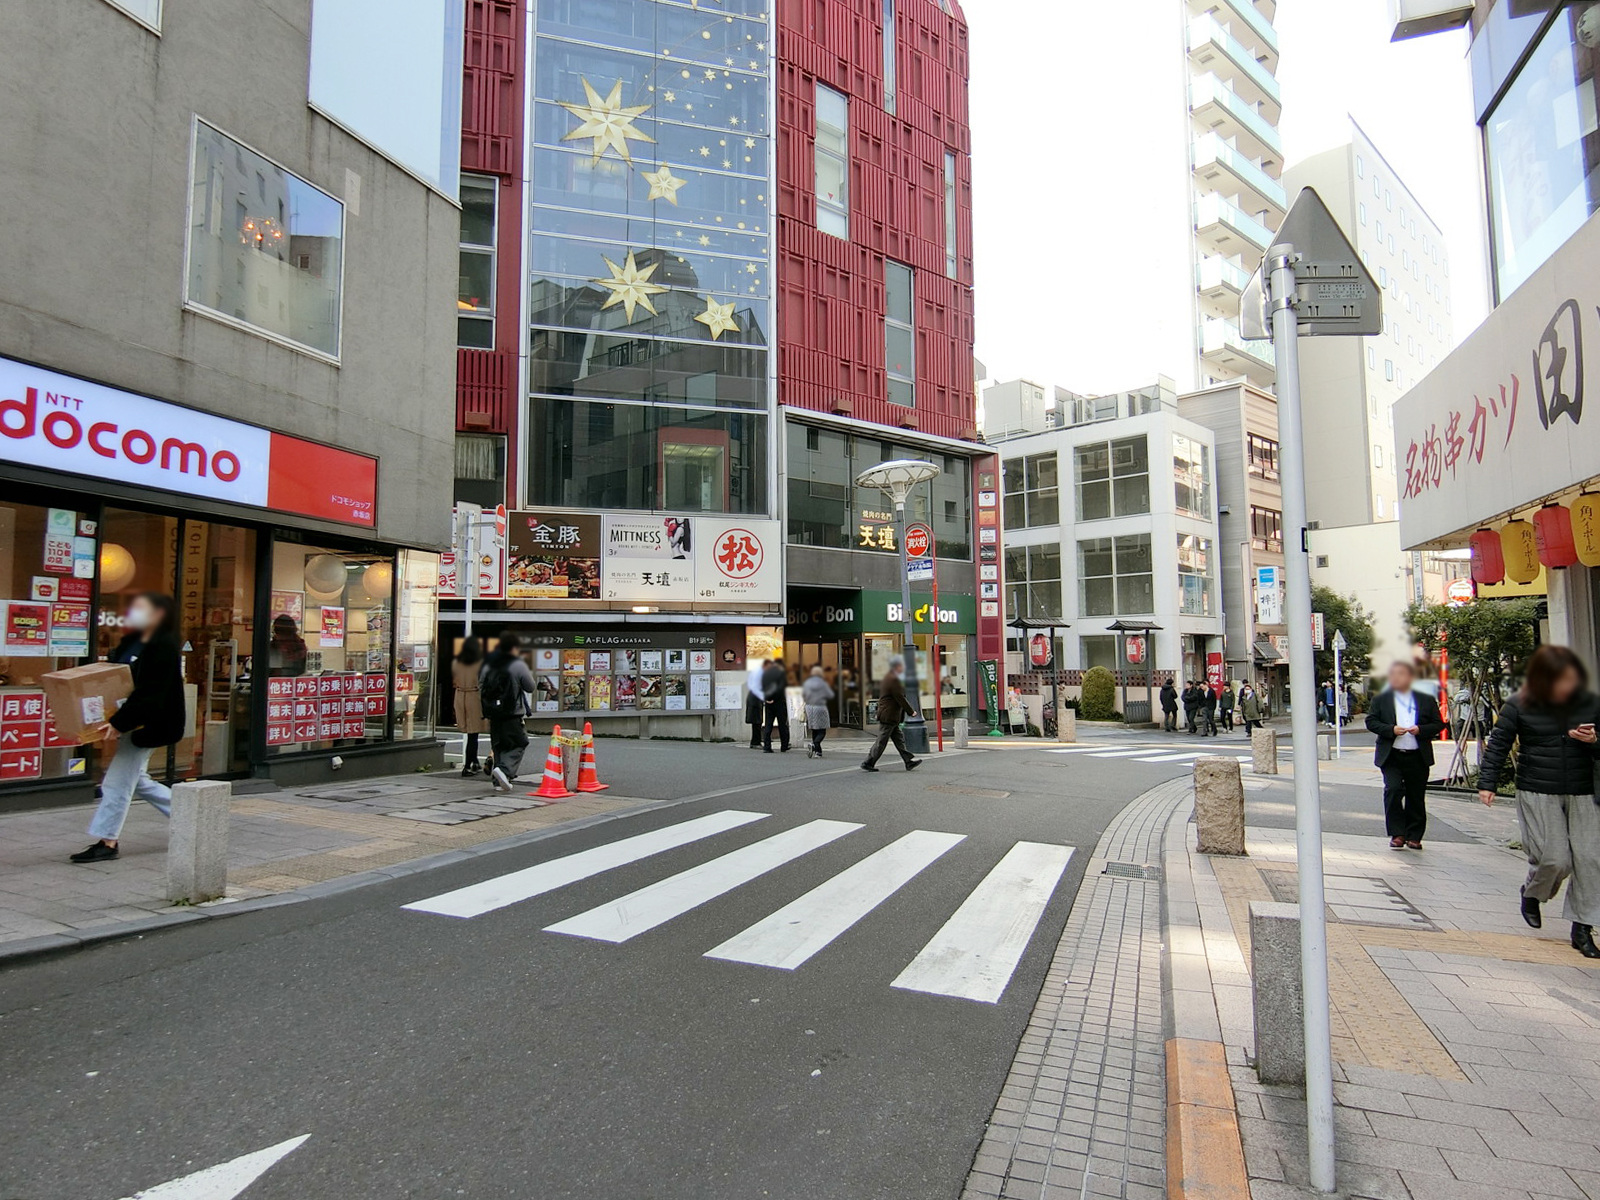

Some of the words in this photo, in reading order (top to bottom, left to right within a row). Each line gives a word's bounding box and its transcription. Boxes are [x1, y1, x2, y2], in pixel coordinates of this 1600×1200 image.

[46, 391, 84, 411] NTT
[0, 386, 241, 483] docomo
[1403, 373, 1520, 500] 名物串カツ
[331, 494, 372, 510] ドコモショップ
[862, 509, 893, 521] 焼肉の名門
[530, 524, 581, 544] 金豚
[610, 529, 661, 544] MITTNESS
[1580, 505, 1594, 552] 角ハイボール
[859, 525, 897, 551] 天壇
[907, 535, 927, 549] 消火栓
[608, 548, 618, 556] 3F
[718, 534, 759, 573] 松
[641, 571, 671, 587] 天壇
[608, 590, 618, 598] 2F
[787, 608, 809, 625] Bio
[826, 604, 854, 623] Bon
[586, 636, 619, 644] A-FLAG
[269, 678, 385, 695] 他社からお乗り換えの
